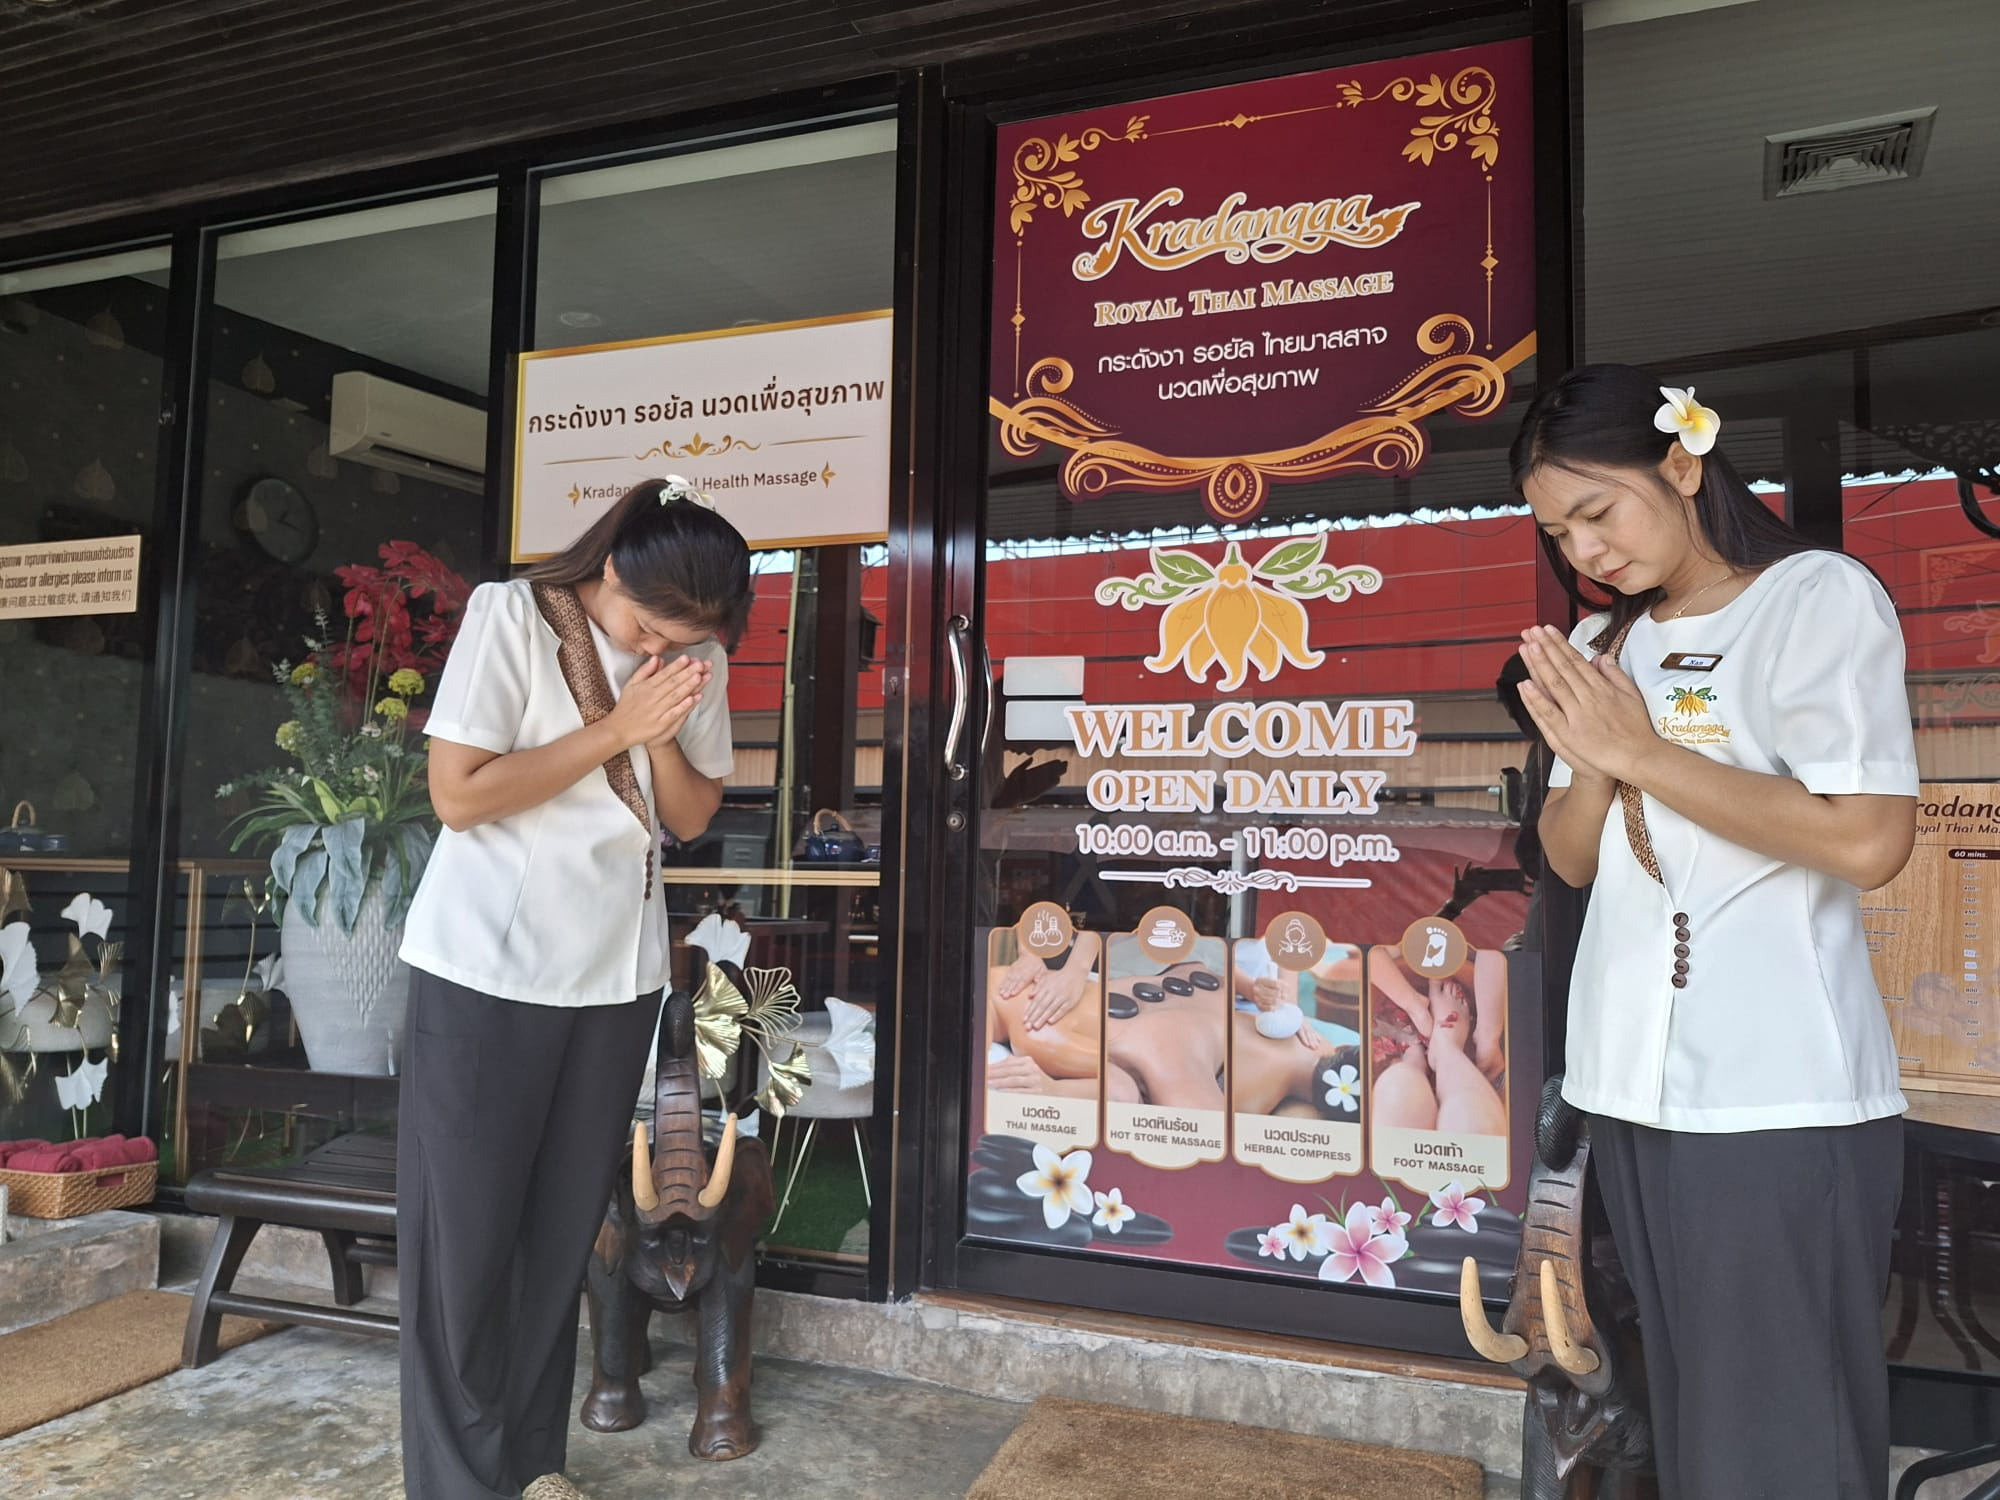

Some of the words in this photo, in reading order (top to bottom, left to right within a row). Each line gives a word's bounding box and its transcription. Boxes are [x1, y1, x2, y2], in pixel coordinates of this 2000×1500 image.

[1072, 187, 1421, 281] Kradangga
[1094, 298, 1183, 327] ROYAL
[1188, 288, 1256, 316] THAI
[1261, 272, 1395, 307] MASSAGE
[1098, 347, 1184, 374] กระดังงา
[1193, 336, 1255, 364] รอยัล
[1262, 324, 1388, 358] ไทยมาสสาจ
[1158, 365, 1320, 401] นวดเพื่อสุขภาพ
[528, 403, 627, 434] กระดังงา
[634, 394, 694, 424] รอยัล
[702, 375, 885, 418] นวดเพื่อสุขภาพ
[583, 483, 632, 500] Kradan
[702, 472, 750, 492] Health
[753, 469, 818, 489] Massage
[5, 574, 28, 589] issues
[29, 576, 37, 587] or
[39, 571, 70, 588] allergies
[71, 570, 96, 587] please
[97, 568, 121, 583] inform
[123, 569, 133, 581] us
[1065, 701, 1416, 757] WELCOME
[1087, 771, 1216, 812] OPEN
[1223, 771, 1386, 814] DAILY
[1945, 822, 1974, 834] Thai
[1077, 825, 1152, 854] 10:00
[1154, 830, 1217, 857] a.m.
[1243, 827, 1327, 860] 11:00
[1330, 833, 1399, 867] p.m.
[1022, 1105, 1061, 1120] นวดตัว
[1005, 1119, 1028, 1131] THAI
[1031, 1122, 1078, 1135] MASSAGE
[1132, 1115, 1199, 1133] นวดหินร้อน
[1110, 1130, 1130, 1140] HOT
[1134, 1131, 1168, 1145] STONE
[1171, 1136, 1222, 1150] MASSAGE
[1264, 1128, 1331, 1146] นวดประคบ
[1244, 1142, 1287, 1156] HERBAL
[1290, 1147, 1352, 1162] COMPRESS
[1414, 1141, 1464, 1158] นวดเท้า
[1393, 1157, 1424, 1170] FOOT
[1428, 1160, 1486, 1175] MASSAGE
